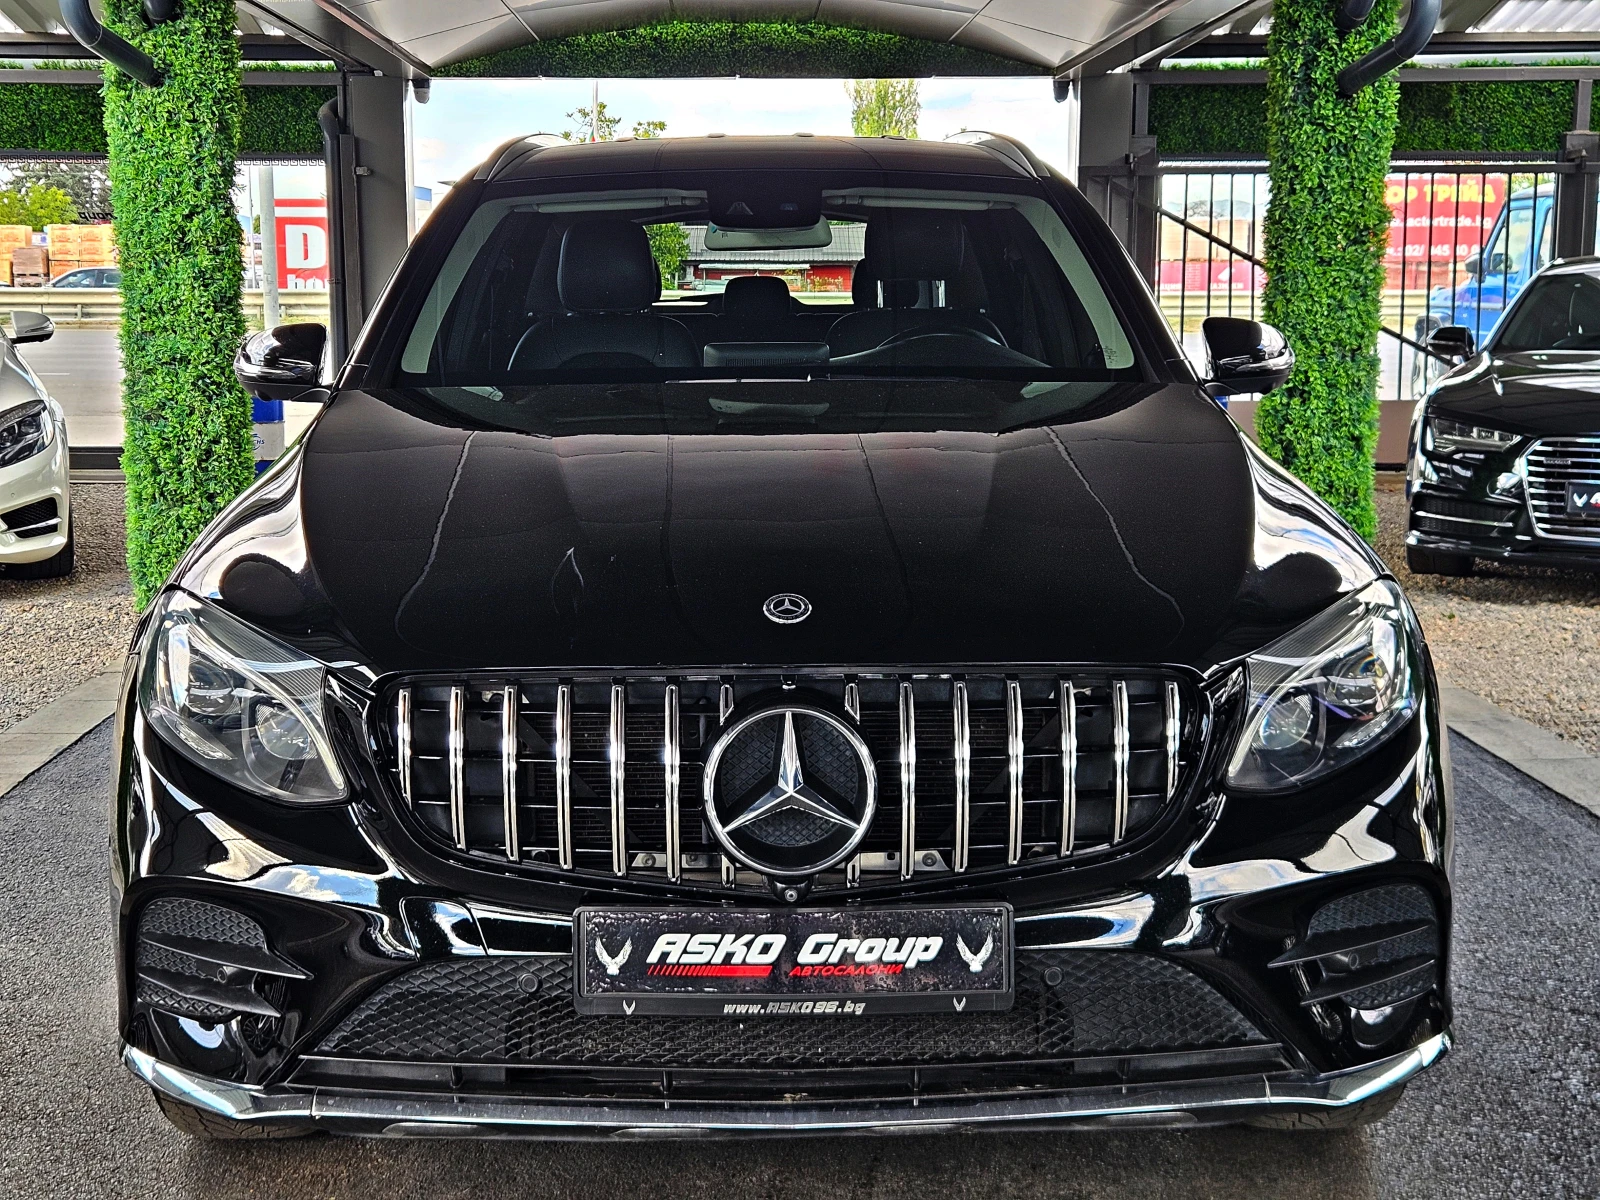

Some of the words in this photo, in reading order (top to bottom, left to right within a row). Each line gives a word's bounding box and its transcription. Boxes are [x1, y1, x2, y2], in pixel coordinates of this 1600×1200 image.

[1430, 244, 1450, 256] 45
[646, 933, 787, 965] ASKO
[797, 933, 943, 969] Group
[789, 964, 904, 977] АВТОСАЛОНИ
